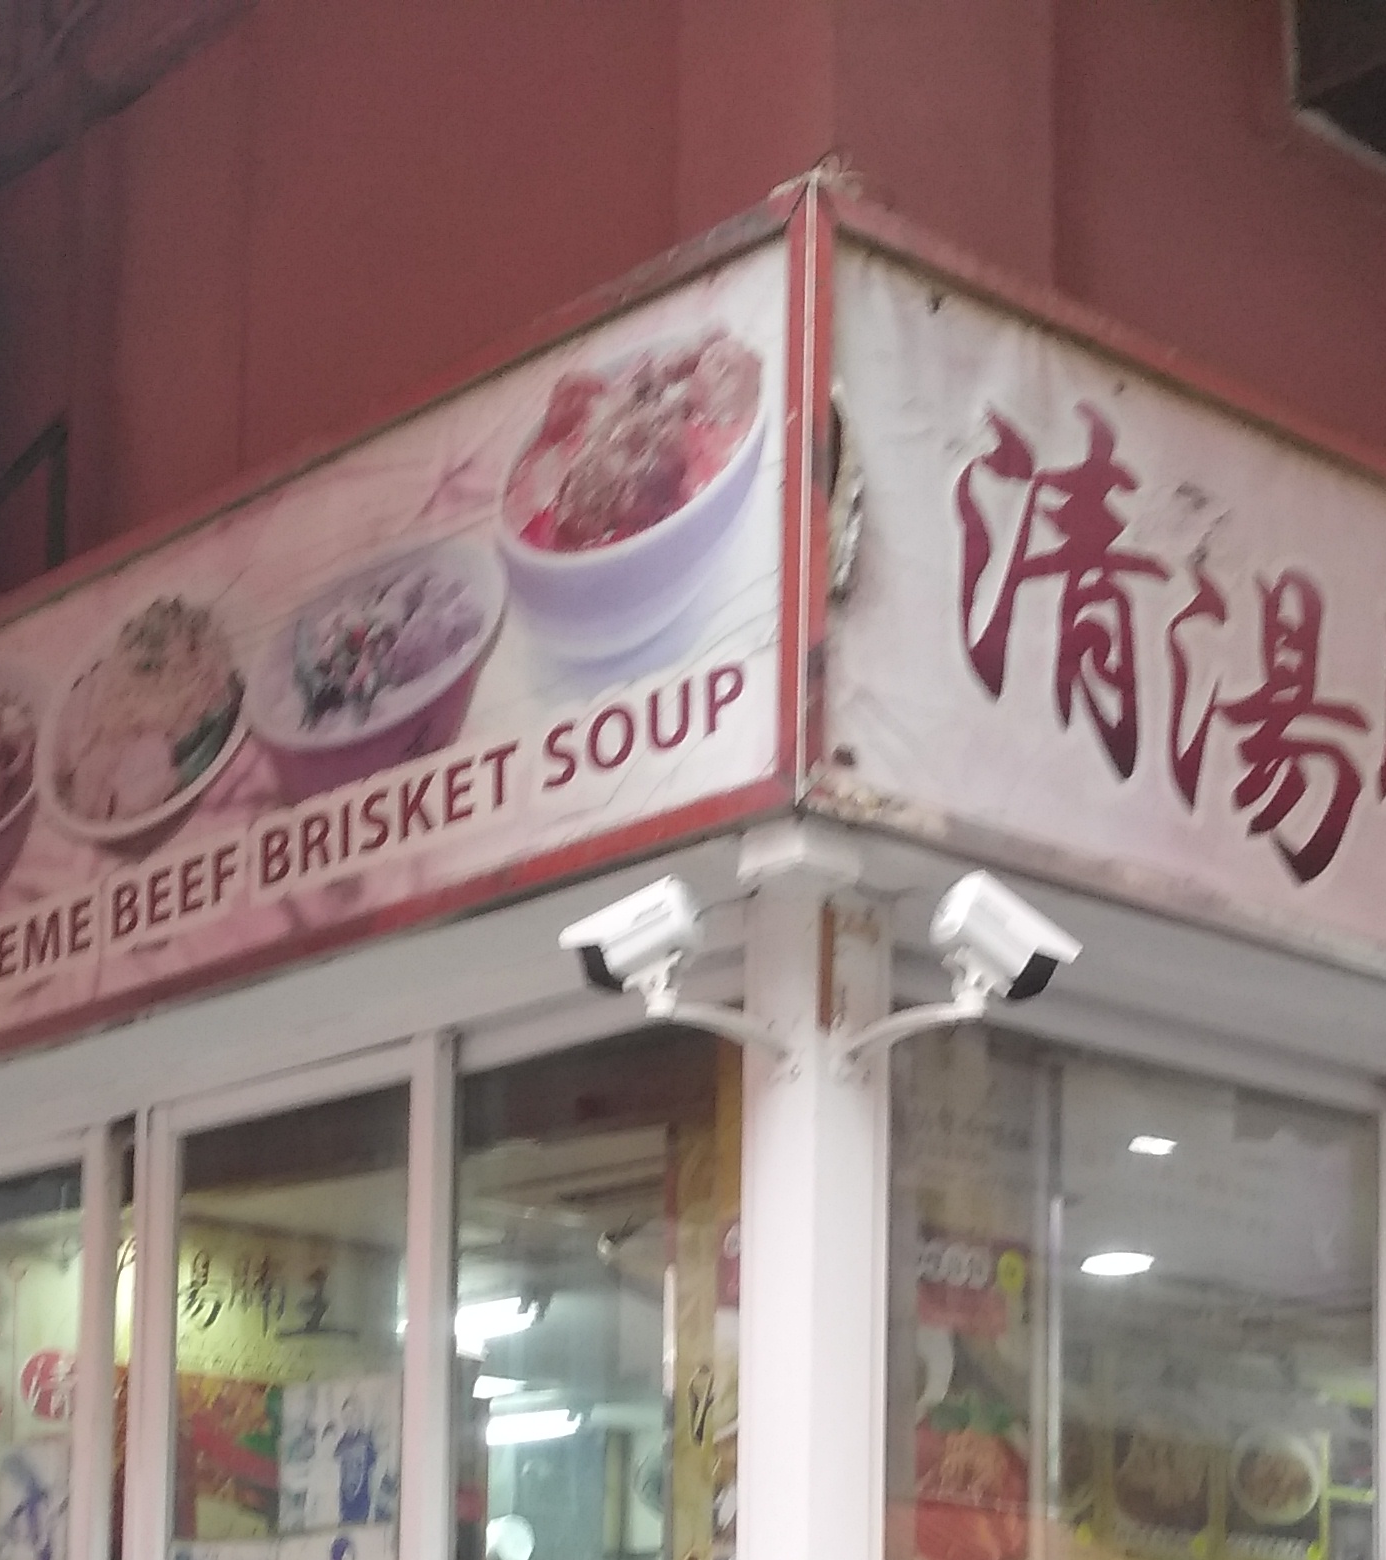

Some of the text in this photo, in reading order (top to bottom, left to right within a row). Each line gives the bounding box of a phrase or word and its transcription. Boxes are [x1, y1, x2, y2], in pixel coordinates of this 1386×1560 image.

[110, 841, 240, 943] BEEF
[257, 739, 521, 888] BRISKET
[541, 662, 747, 792] SOUP
